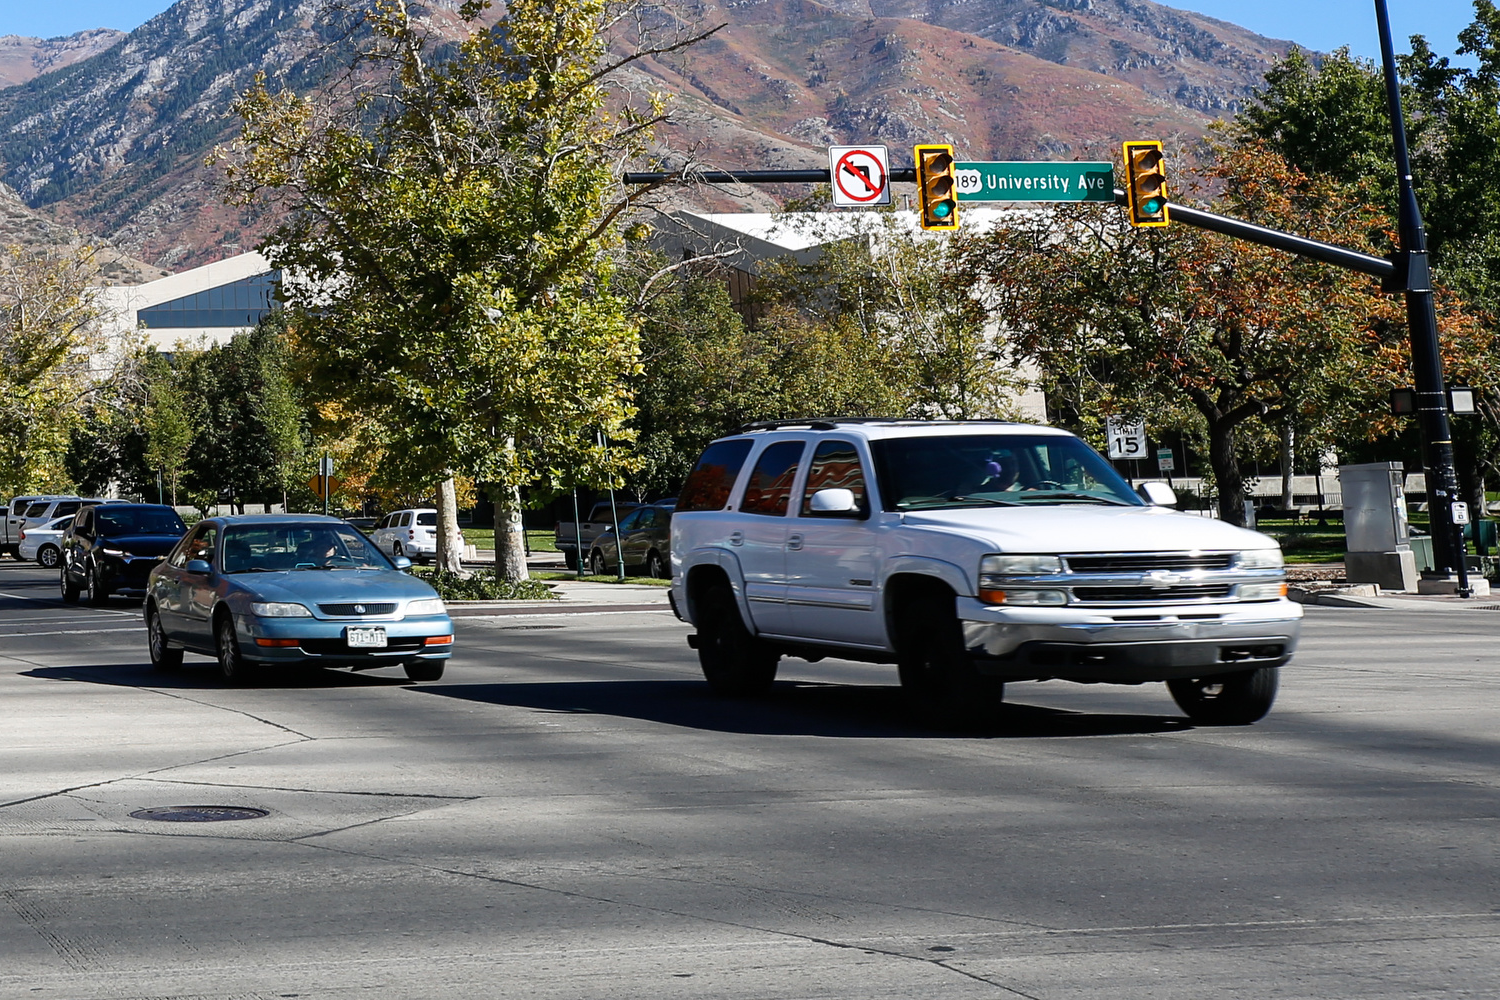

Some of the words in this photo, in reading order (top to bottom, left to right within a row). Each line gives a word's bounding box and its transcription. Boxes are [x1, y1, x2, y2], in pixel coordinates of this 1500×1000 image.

[956, 175, 978, 188] 189
[987, 174, 1070, 193] University
[1078, 174, 1105, 189] Ave
[1113, 427, 1138, 435] LIMIT
[1115, 437, 1139, 453] 15
